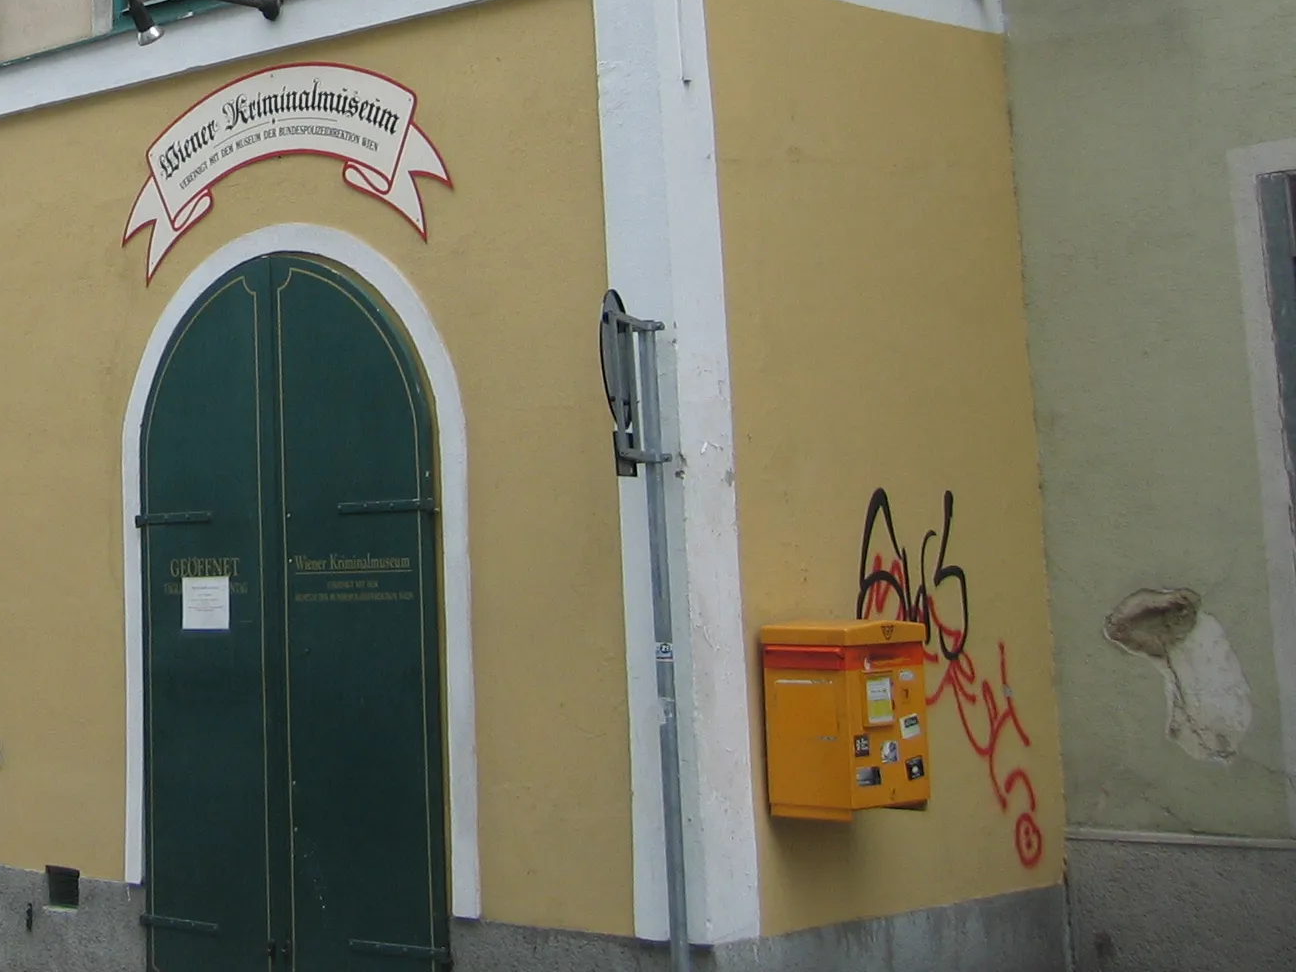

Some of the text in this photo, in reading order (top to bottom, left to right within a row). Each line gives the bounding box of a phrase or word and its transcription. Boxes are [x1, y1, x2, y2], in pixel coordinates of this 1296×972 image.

[159, 78, 400, 181] Wiener Kriminalmuseum
[179, 125, 379, 190] VEREINIGT MIT DEM MUSEUM DER BUNDESPOLIZEIDIREKTION WIEN
[294, 552, 410, 570] Wiener Kriminalmuseum
